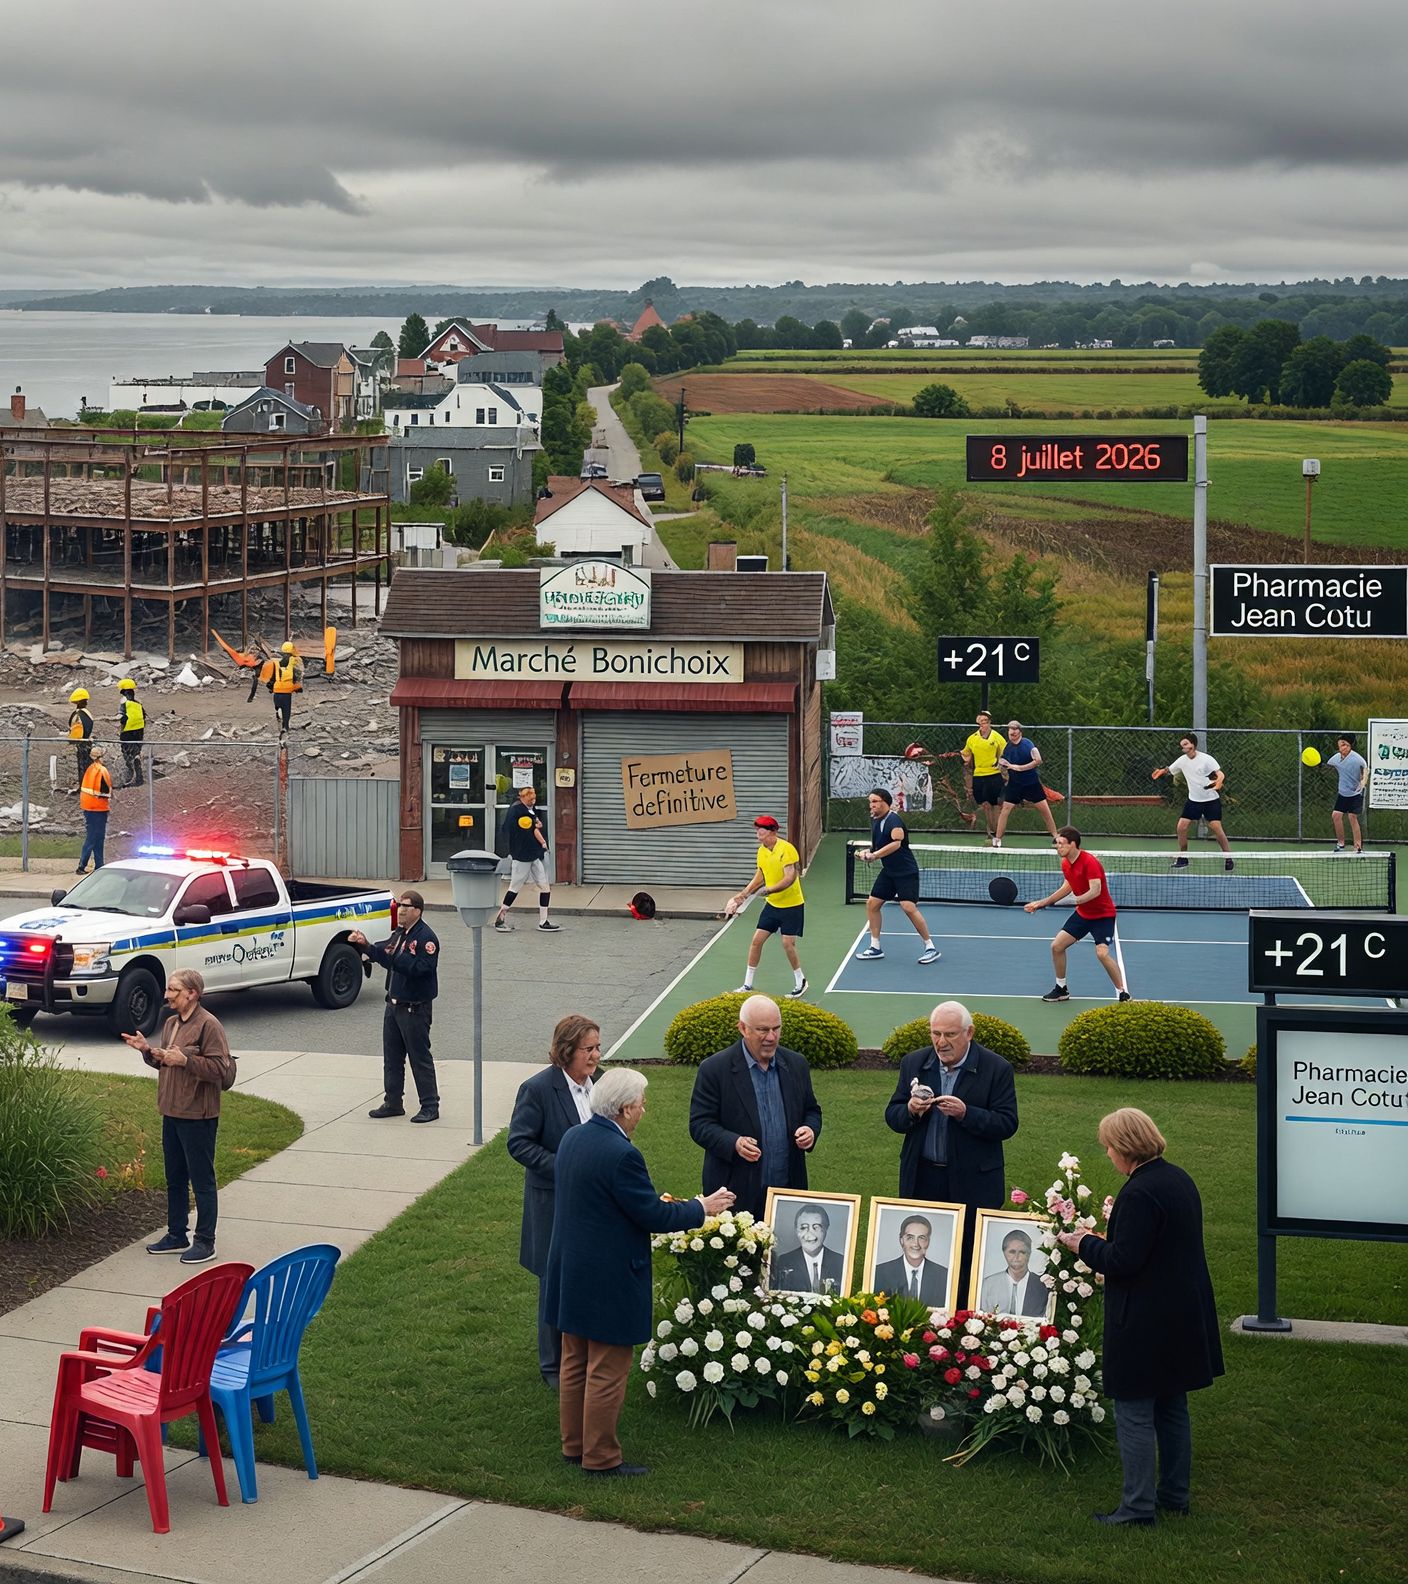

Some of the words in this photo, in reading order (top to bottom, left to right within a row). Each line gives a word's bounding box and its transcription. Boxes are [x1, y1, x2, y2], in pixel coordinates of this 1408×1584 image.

[991, 444, 1007, 470] 8
[1017, 443, 1084, 478] juillet
[1095, 443, 1161, 470] 2026
[1233, 571, 1382, 598] Pharmacie
[1230, 602, 1296, 628] Jean
[1305, 602, 1372, 628] Cotu
[471, 645, 577, 673] Marché
[592, 647, 730, 675] Bonichoix
[943, 642, 1004, 677] +21
[627, 760, 728, 789] Fermeture
[632, 788, 729, 817] definitive
[1264, 932, 1347, 977] +21
[1293, 1060, 1407, 1084] Pharmacie
[1292, 1085, 1343, 1106] Jean
[1351, 1087, 1408, 1108] Cotu
